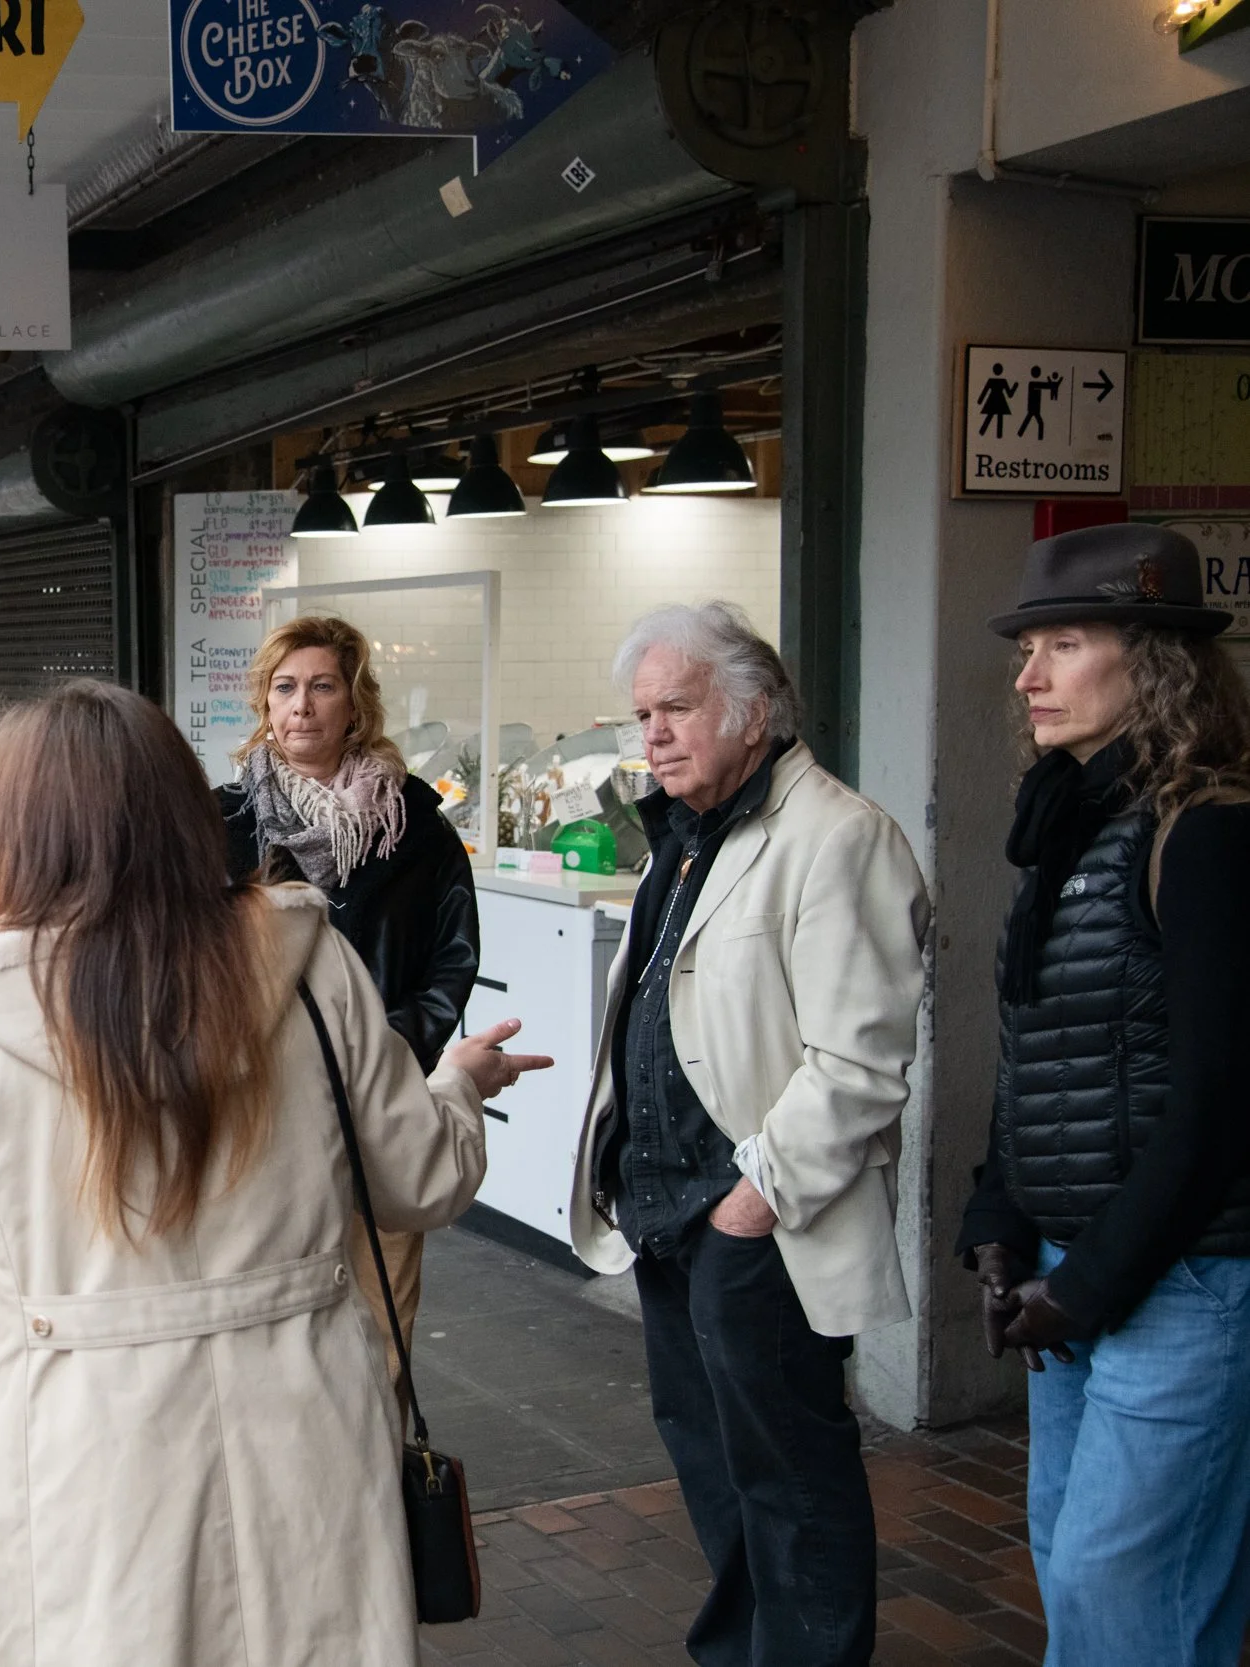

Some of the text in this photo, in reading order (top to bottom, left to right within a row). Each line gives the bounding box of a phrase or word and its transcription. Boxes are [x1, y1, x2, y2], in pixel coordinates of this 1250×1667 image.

[201, 14, 306, 67] CHEESE
[224, 55, 292, 104] BOX
[974, 454, 1110, 481] Restrooms
[190, 519, 207, 614] SPECIAL
[190, 638, 207, 682] TEA
